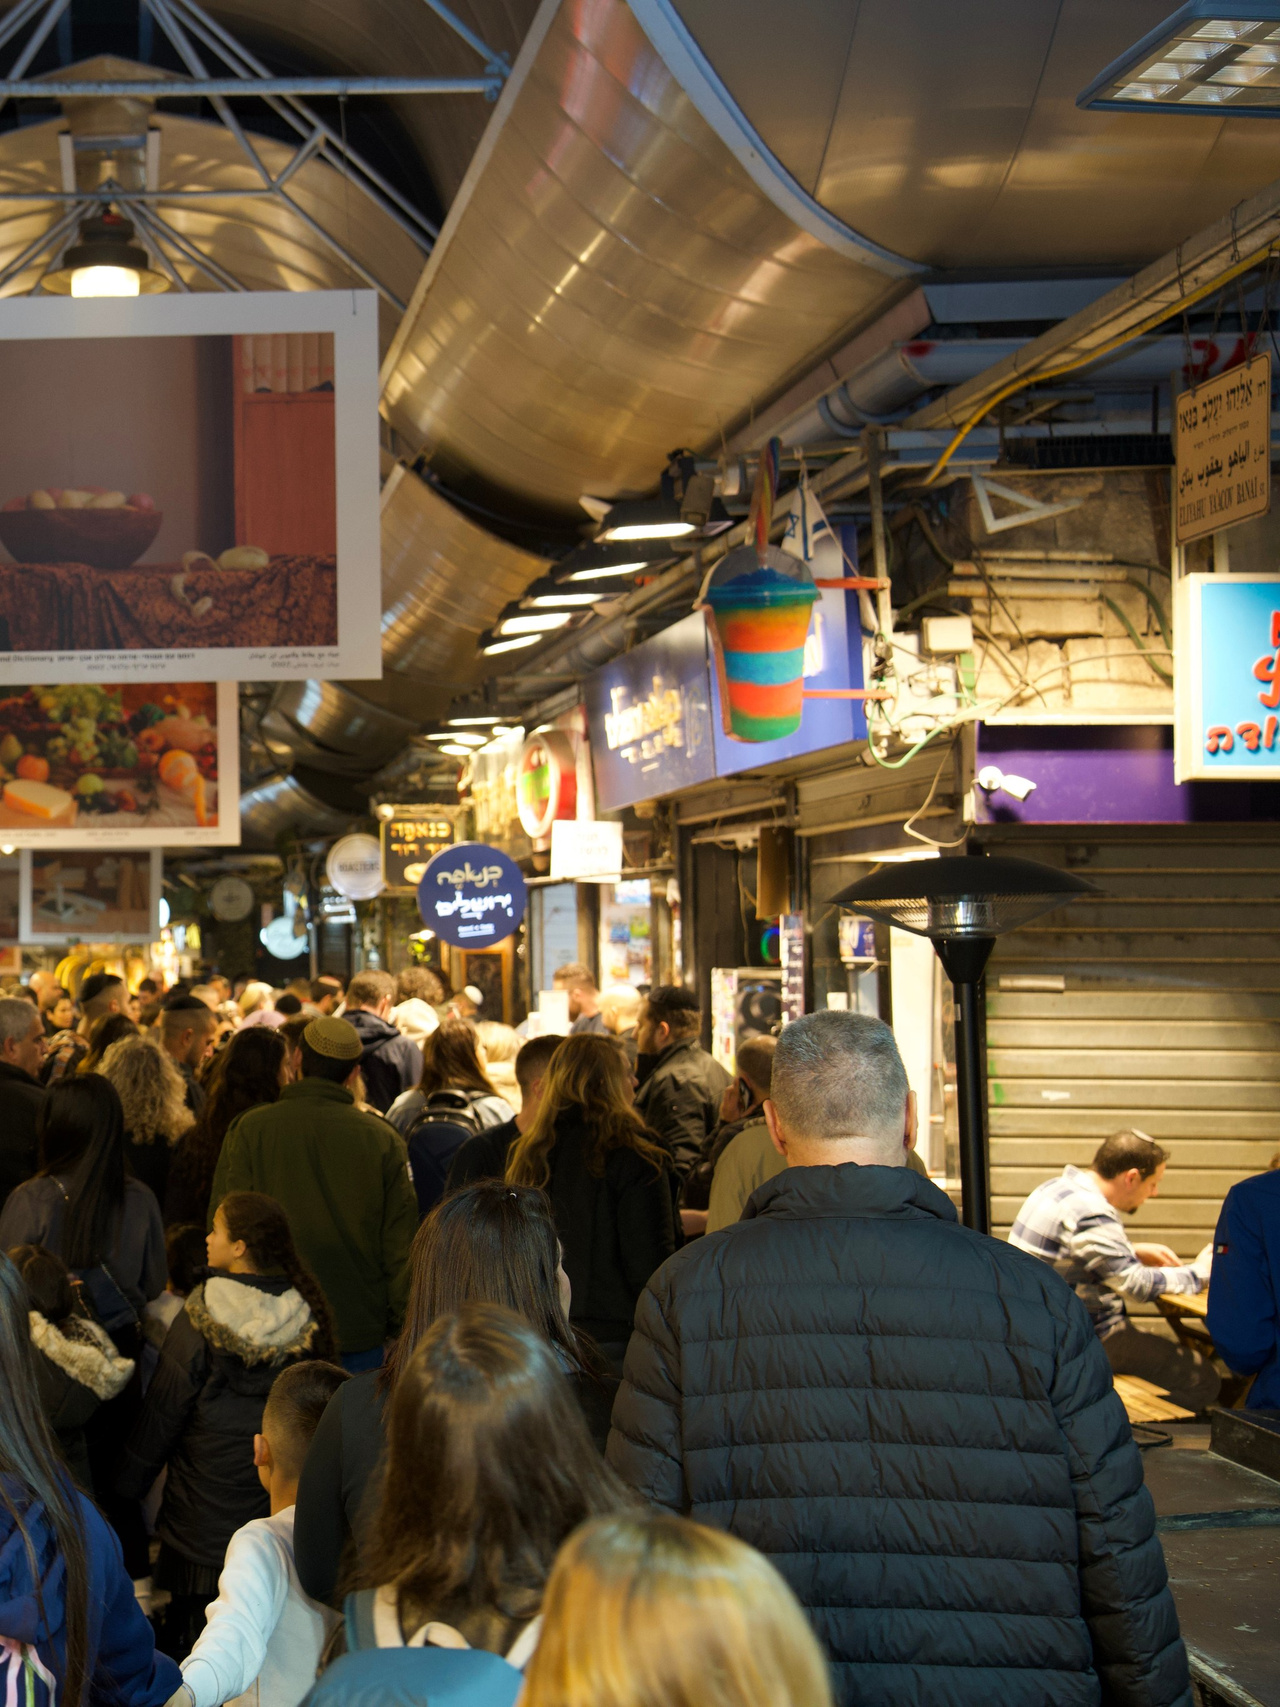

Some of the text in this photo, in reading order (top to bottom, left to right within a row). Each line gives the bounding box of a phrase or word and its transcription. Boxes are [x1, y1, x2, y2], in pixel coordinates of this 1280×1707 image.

[1179, 499, 1206, 528] ELIYAHU
[1236, 476, 1258, 505] BANAI
[390, 822, 452, 842] כנאפה
